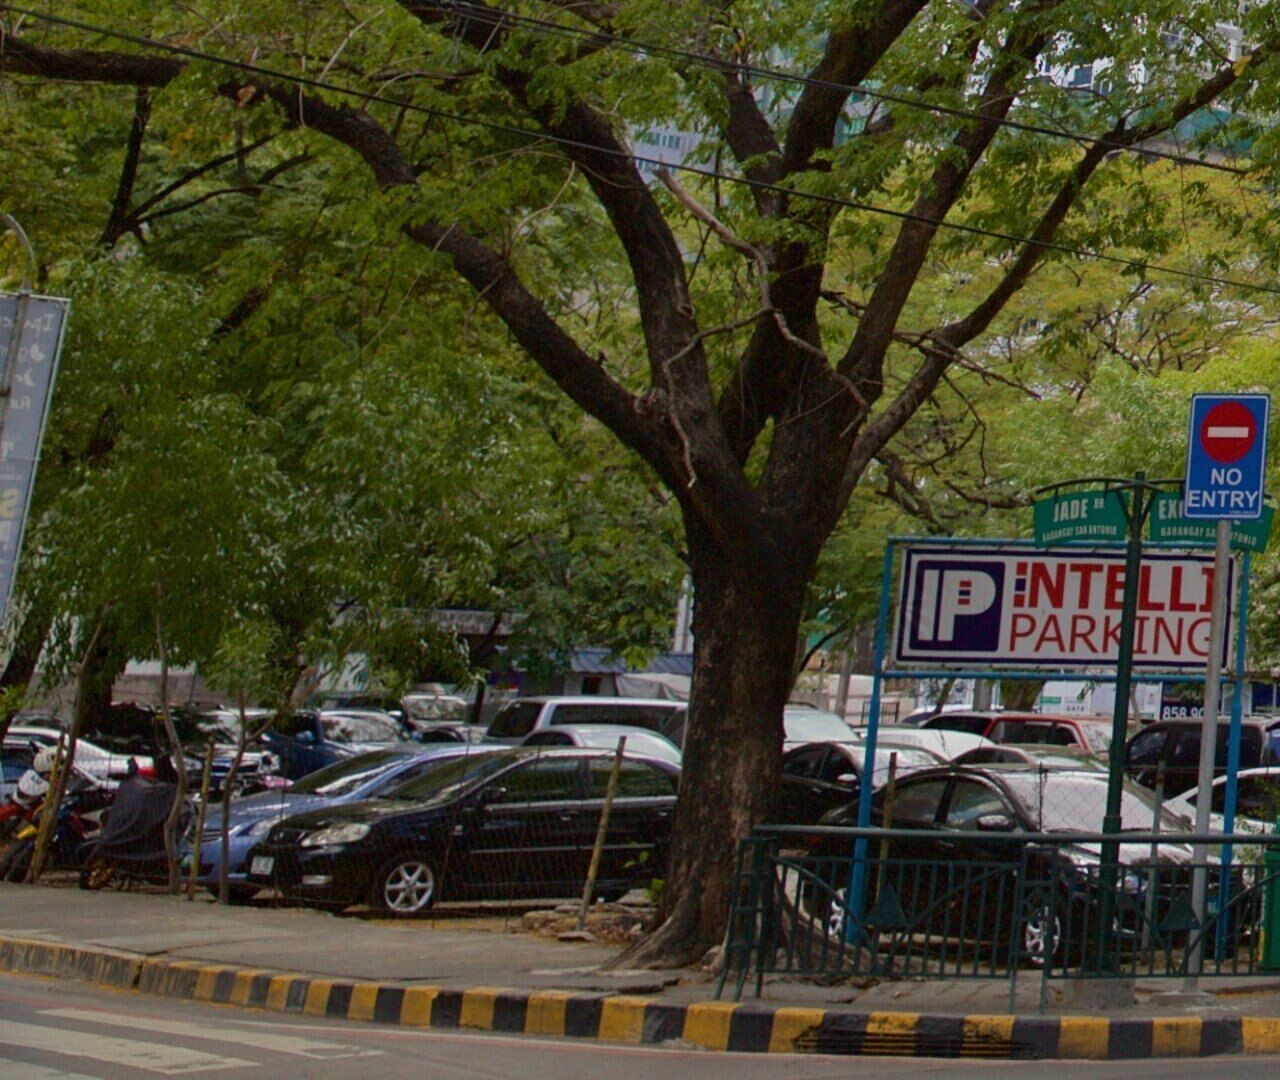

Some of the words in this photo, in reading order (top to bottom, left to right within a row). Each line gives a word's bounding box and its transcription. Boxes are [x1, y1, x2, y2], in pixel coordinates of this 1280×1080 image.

[1210, 468, 1243, 486] NO
[1187, 489, 1260, 510] ENTRY
[1053, 498, 1089, 523] JADE
[1160, 525, 1204, 537] BARANGAY
[1009, 613, 1212, 657] PARKING
